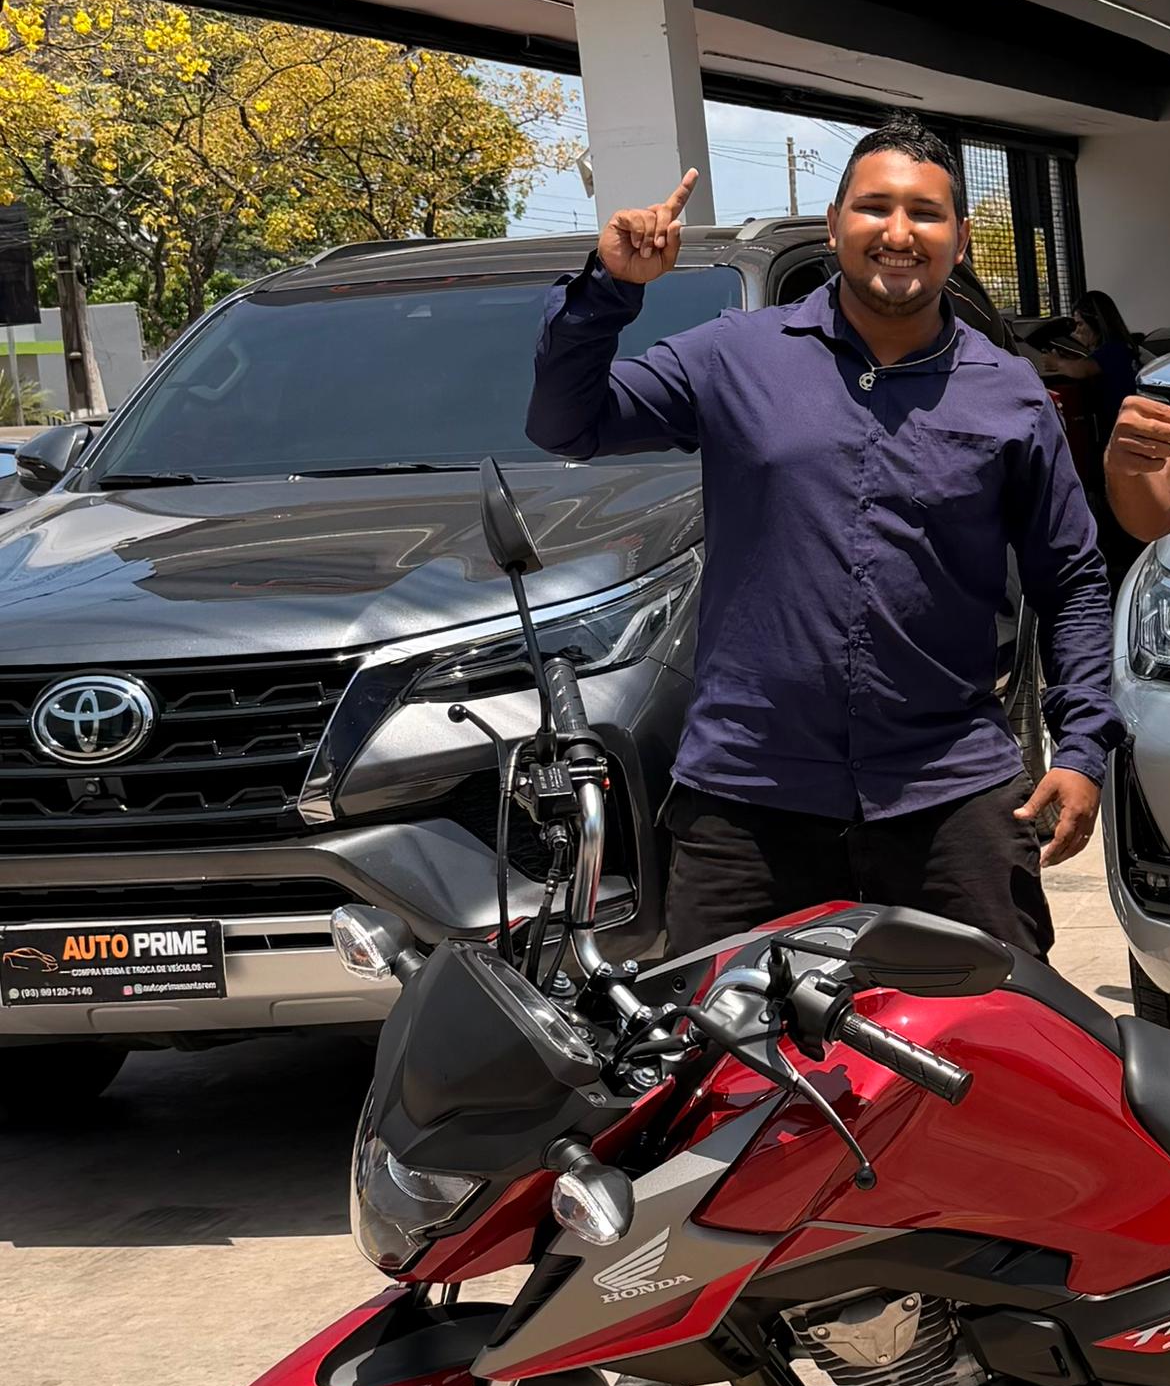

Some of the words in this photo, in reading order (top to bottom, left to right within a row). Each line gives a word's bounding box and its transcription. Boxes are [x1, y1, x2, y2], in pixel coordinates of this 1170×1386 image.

[62, 933, 130, 961] AUTO
[132, 929, 208, 958] PRIME
[600, 1274, 694, 1304] HONDA
